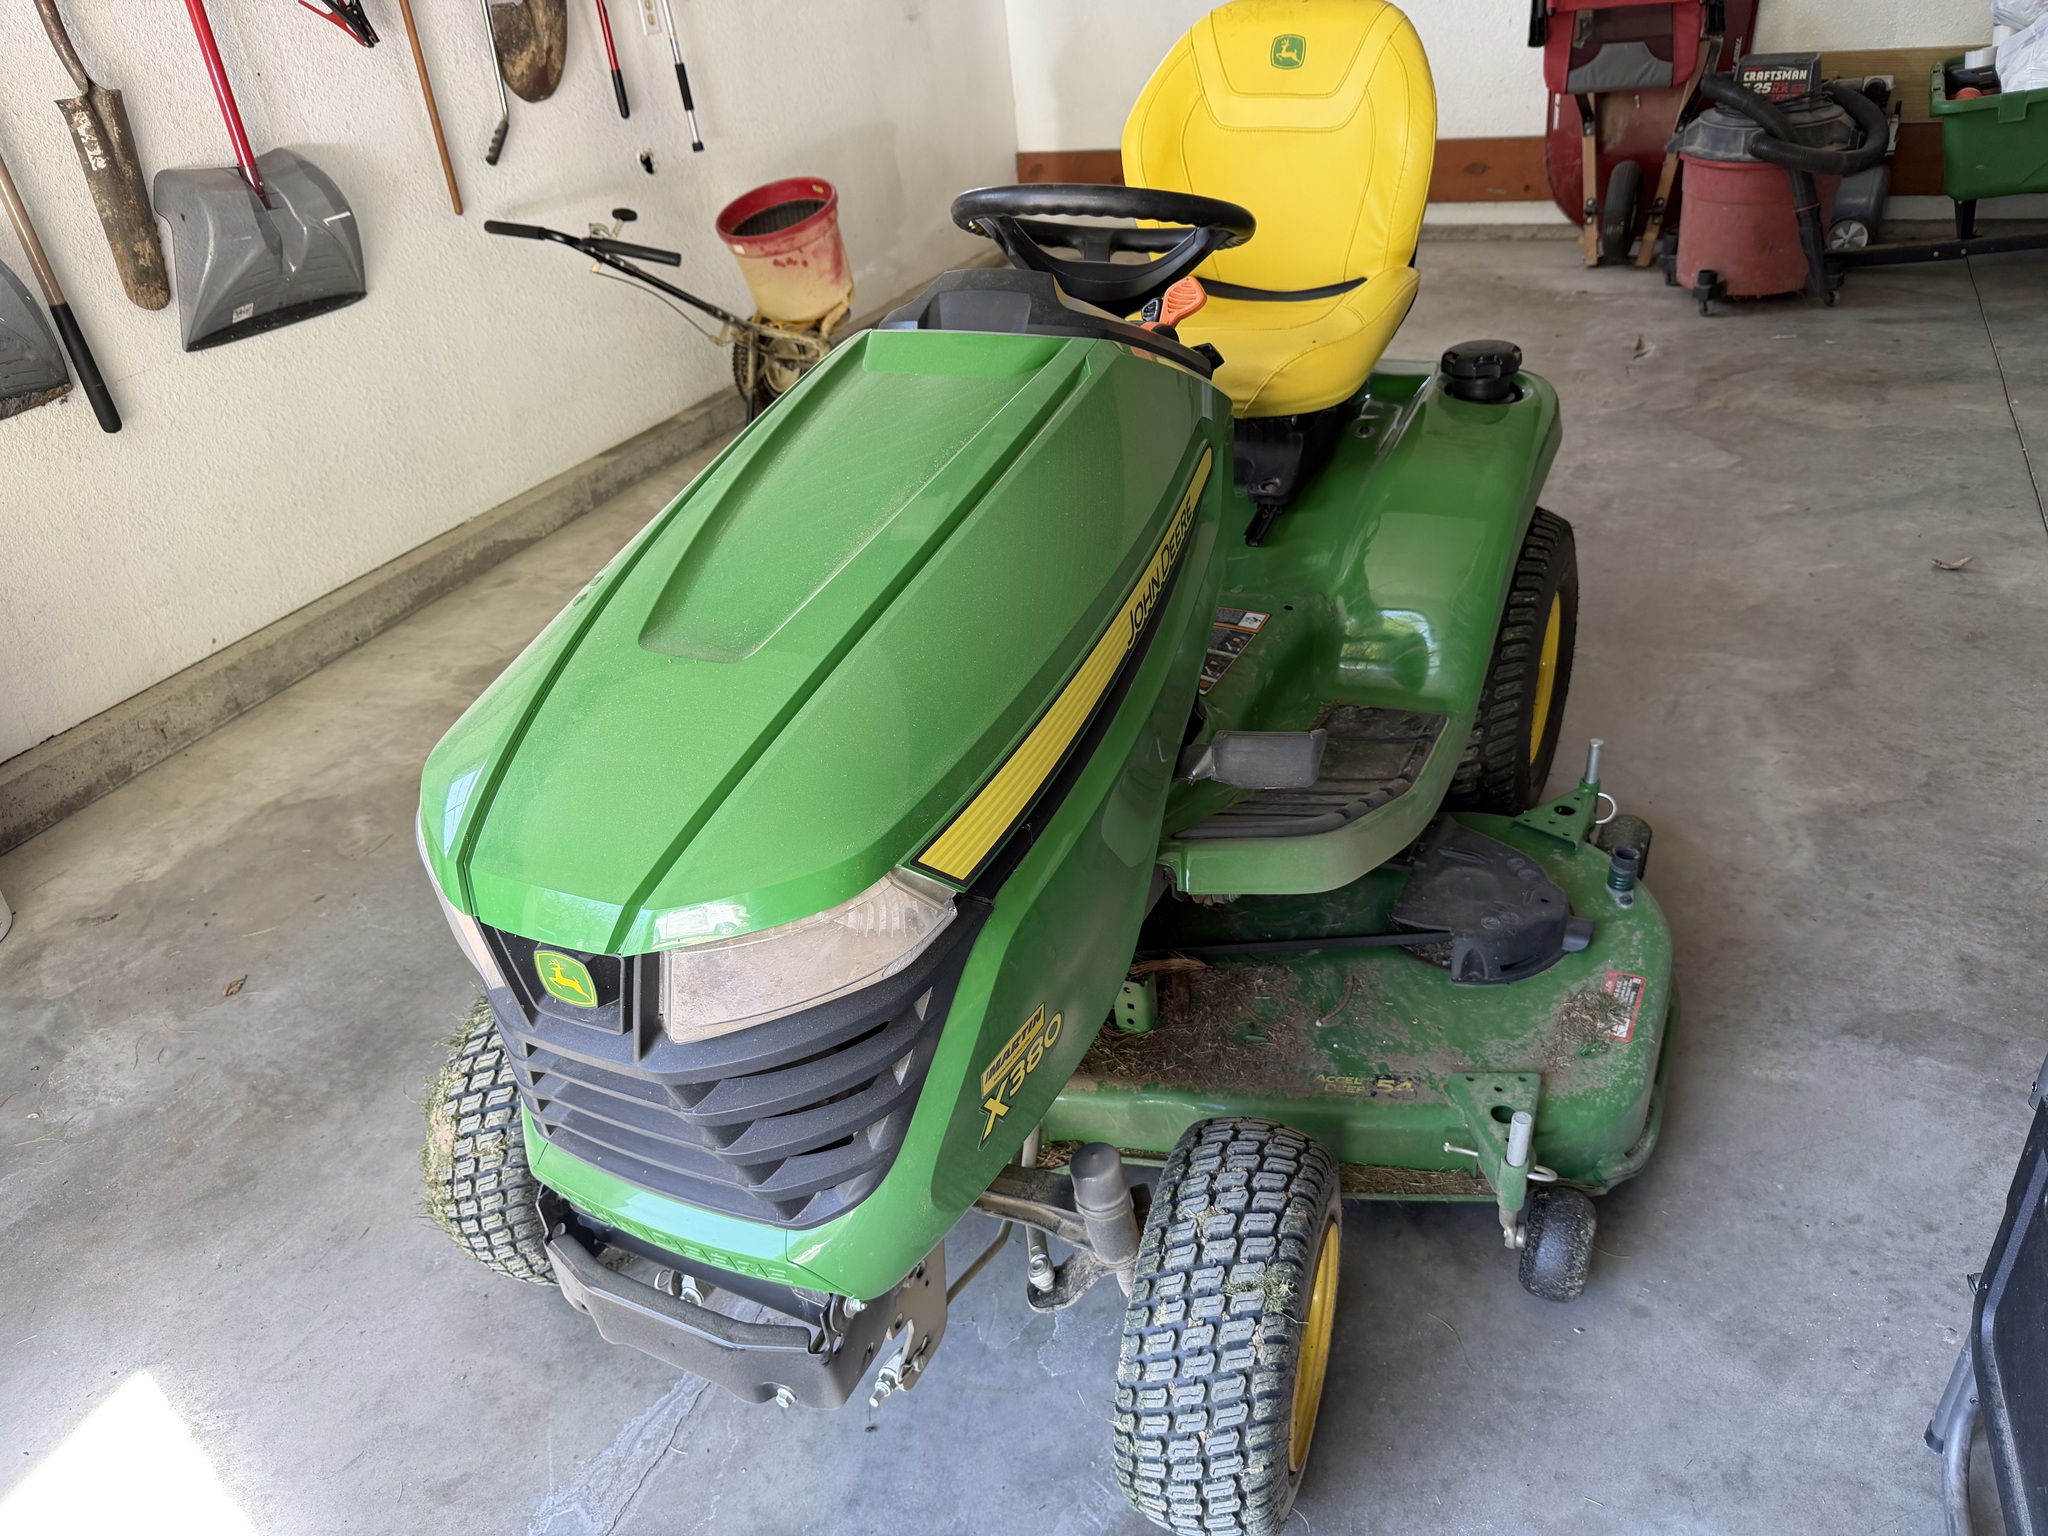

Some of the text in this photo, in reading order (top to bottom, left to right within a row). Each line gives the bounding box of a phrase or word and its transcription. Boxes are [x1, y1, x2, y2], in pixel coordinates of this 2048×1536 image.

[1743, 70, 1808, 81] CRAFTSMAN
[1128, 496, 1193, 646] JOHN DEERE
[979, 1011, 1063, 1146] X380
[1315, 1073, 1362, 1085] ACCEL
[1376, 1079, 1415, 1094] 54
[641, 1225, 794, 1285] DEERE
